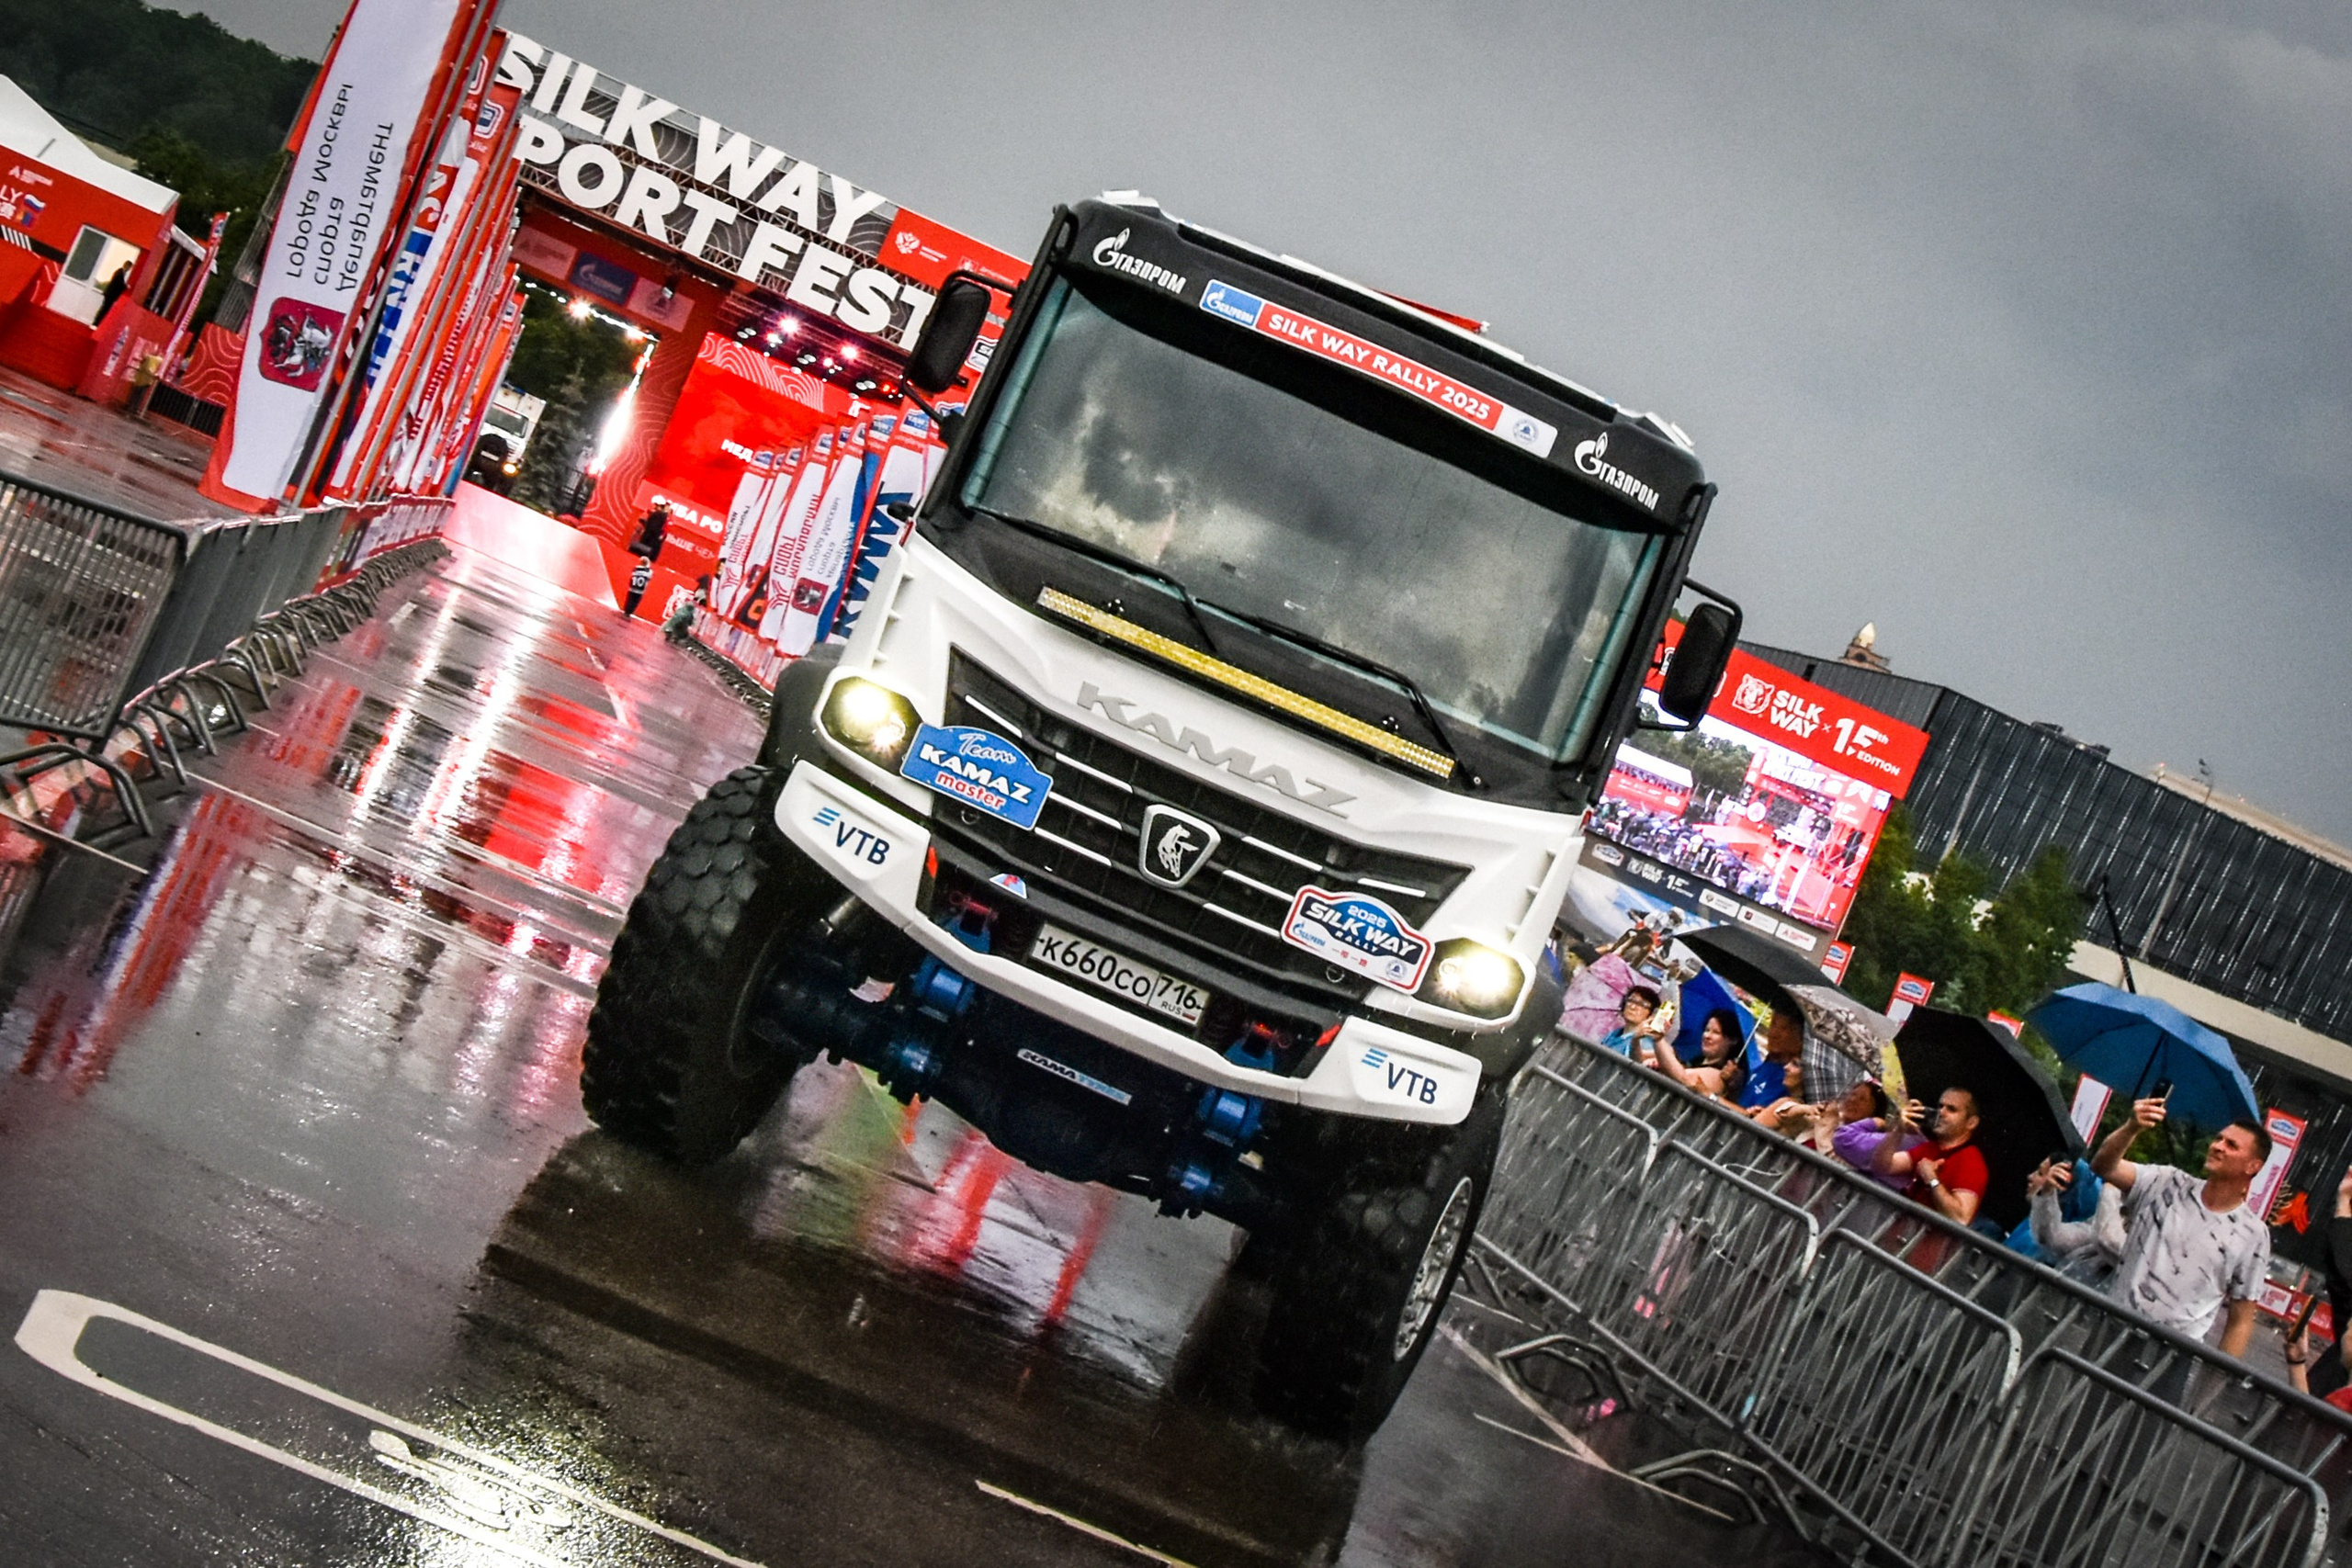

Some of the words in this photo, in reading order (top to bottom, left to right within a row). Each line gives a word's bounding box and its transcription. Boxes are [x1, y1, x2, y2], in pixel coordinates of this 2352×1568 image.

[494, 32, 679, 164] SILK
[694, 116, 887, 243] WAY
[513, 113, 739, 258] PORT
[737, 220, 937, 352] FEST
[1114, 251, 1187, 294] ГАЗПРОМ
[1268, 313, 1317, 344] SILK
[1322, 333, 1371, 364] WAY
[1373, 355, 1441, 393] RALLY
[1441, 386, 1490, 420] 2025
[1599, 462, 1660, 511] ГАЗПРОМ
[1770, 705, 1819, 739] WAY
[1773, 690, 1825, 723] SILK
[958, 732, 1016, 765] Team
[1077, 681, 1357, 820] KAMAZ
[1857, 750, 1902, 776] EDITION
[919, 743, 1034, 805] KAMAZ
[935, 771, 1007, 811] master
[835, 821, 890, 865] VTB
[1306, 901, 1366, 936] SILK
[1364, 926, 1418, 956] WAY
[1347, 905, 1388, 929] 2025
[1335, 931, 1378, 953] RALLY
[1157, 976, 1198, 1010] 716
[1160, 1000, 1182, 1015] RUS
[1388, 1062, 1438, 1104] VTB
